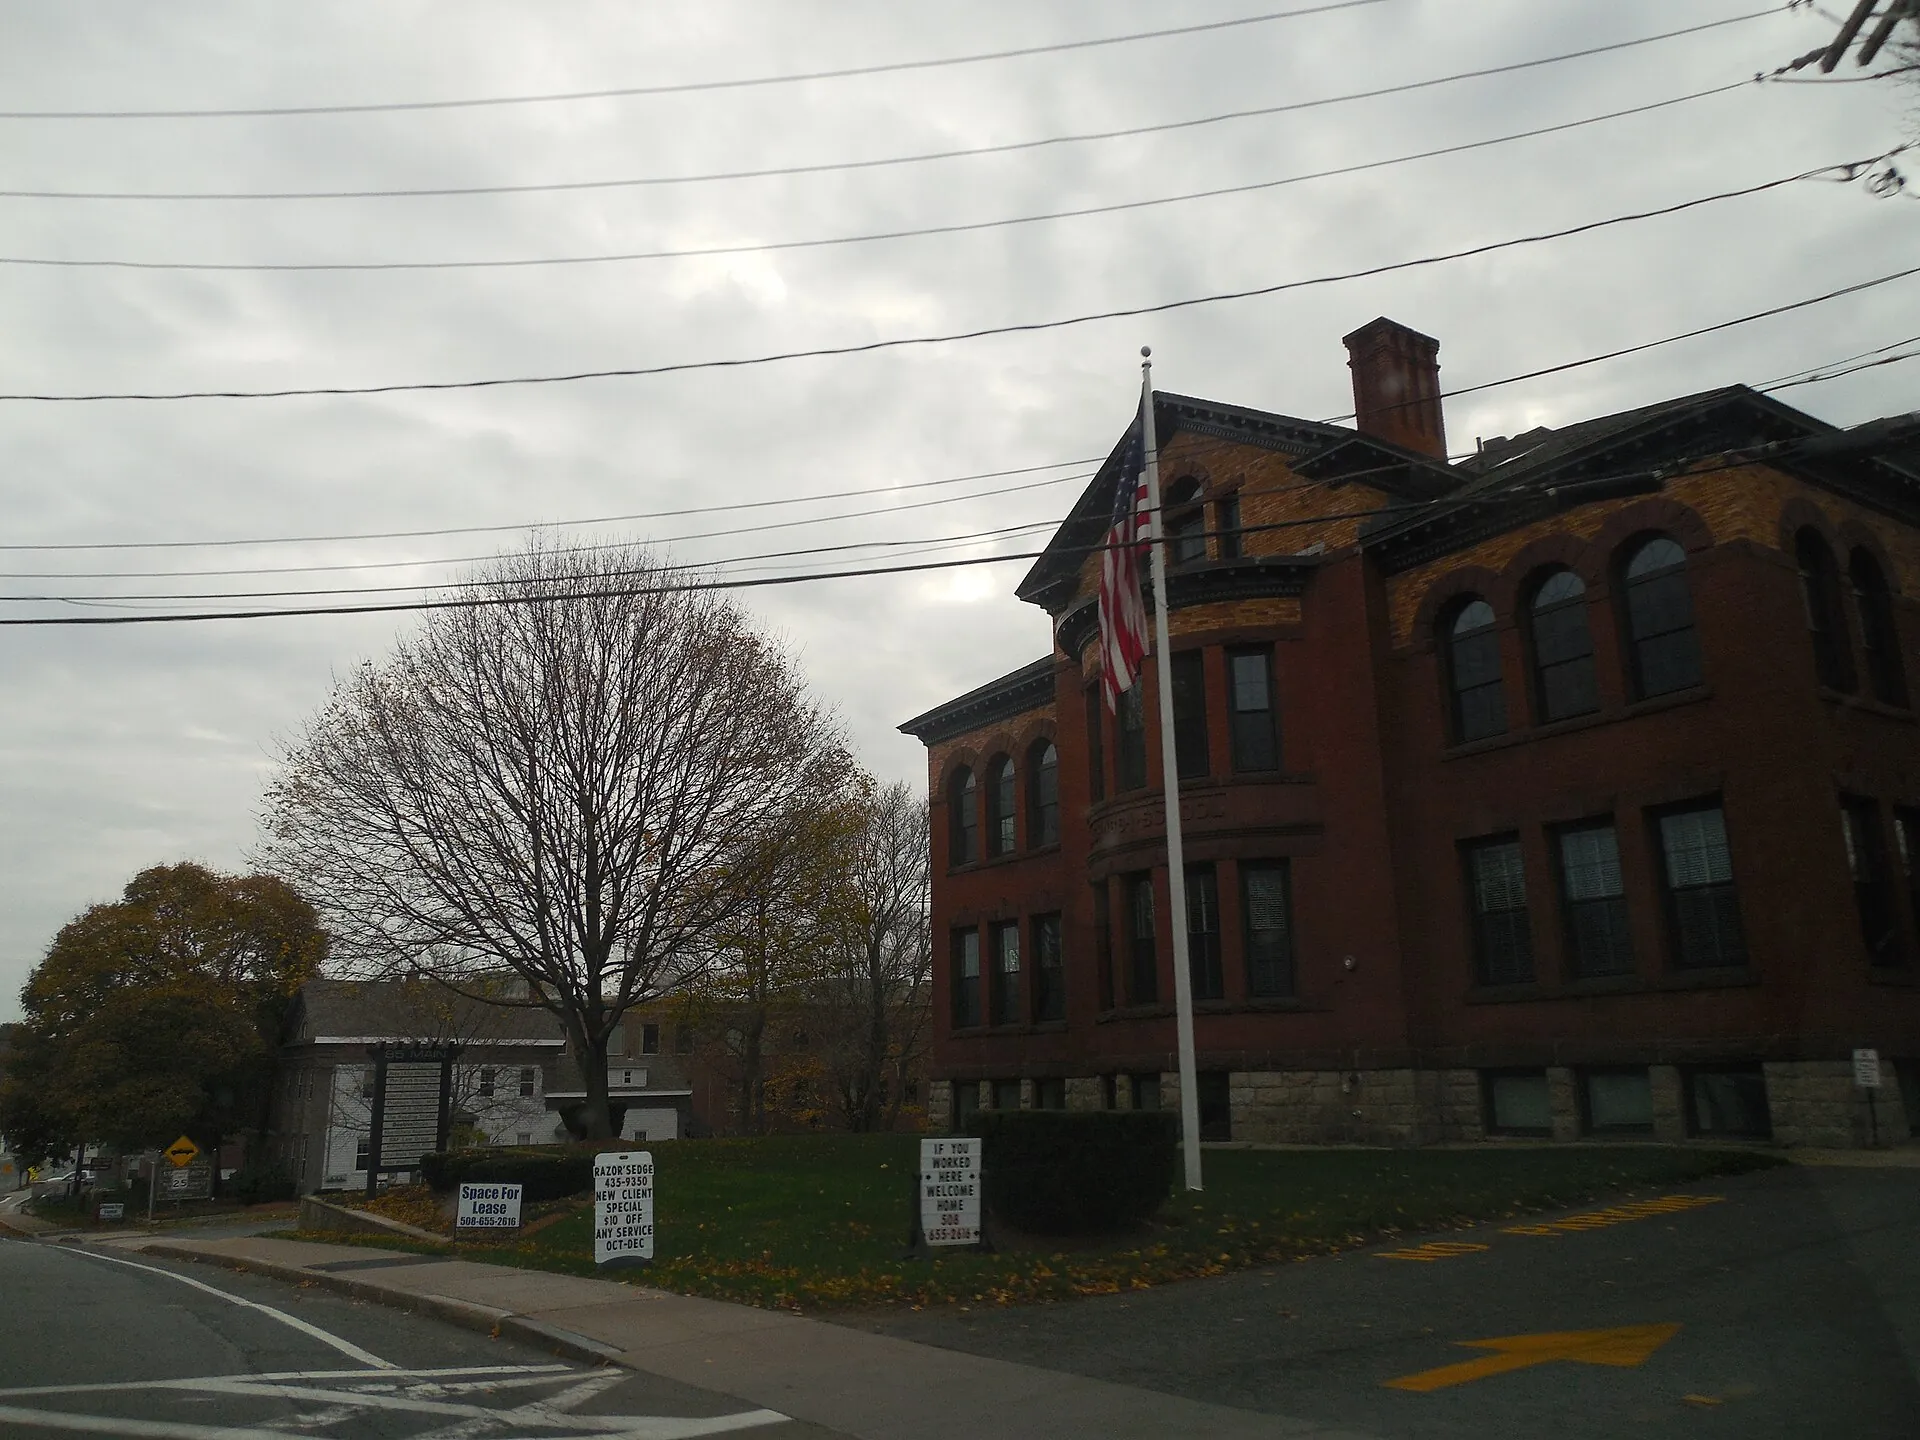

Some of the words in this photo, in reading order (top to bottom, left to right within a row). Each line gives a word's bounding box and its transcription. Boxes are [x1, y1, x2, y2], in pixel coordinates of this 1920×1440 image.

[410, 1049, 447, 1058] MAIN
[934, 1143, 944, 1155] IF
[951, 1143, 969, 1154] YOU
[932, 1157, 971, 1168] WORKED
[605, 1177, 647, 1188] 435-9350
[938, 1171, 962, 1182] HERE
[173, 1179, 188, 1188] 25
[462, 1186, 499, 1200] Space
[501, 1187, 520, 1200] For
[596, 1190, 616, 1201] NEW
[622, 1188, 652, 1200] CLIENT
[926, 1185, 974, 1197] WELCOME
[472, 1201, 507, 1214] Lease
[606, 1202, 643, 1213] SPECIAL
[937, 1200, 964, 1211] HOME
[460, 1216, 517, 1226] 508-655-2616
[604, 1215, 618, 1226] $10
[626, 1213, 643, 1224] OFF
[941, 1214, 959, 1226] 508
[596, 1228, 613, 1239] ANY
[616, 1225, 652, 1238] SERVICE
[606, 1238, 644, 1251] OCT-DEC
